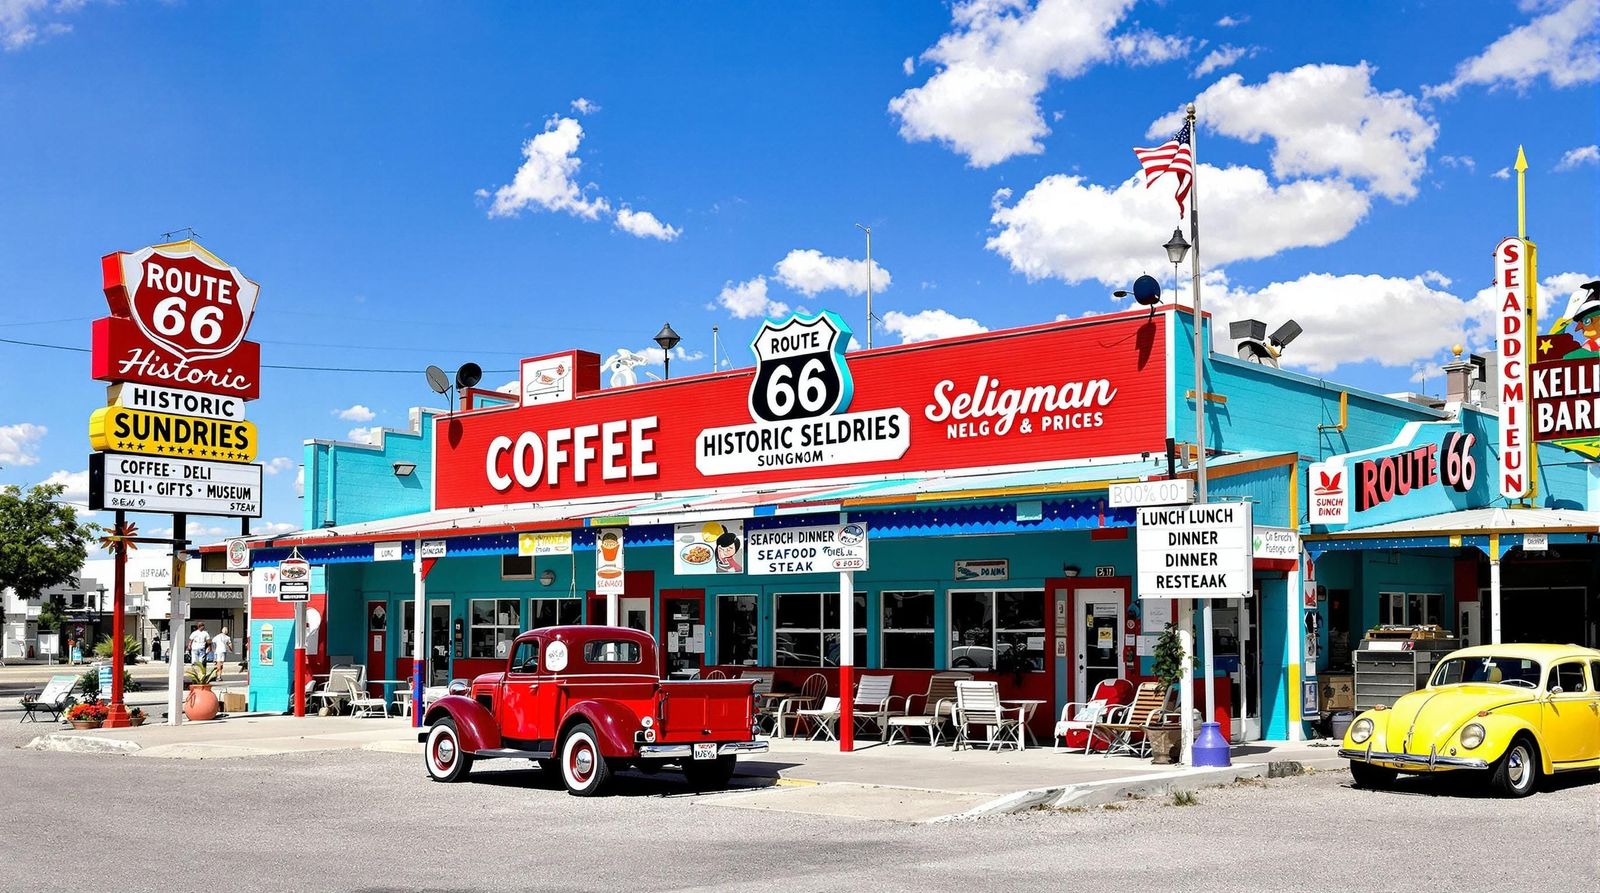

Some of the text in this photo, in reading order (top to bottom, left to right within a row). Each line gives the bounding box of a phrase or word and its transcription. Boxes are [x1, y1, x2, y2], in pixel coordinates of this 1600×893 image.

[147, 261, 233, 305] ROUTE
[152, 296, 224, 346] 66
[771, 331, 820, 354] ROUTE
[118, 347, 252, 391] Historic
[766, 357, 827, 417] 66
[134, 387, 235, 417] HISTORIC
[924, 375, 1118, 436] Seligman
[114, 411, 249, 450] SUNDRIES
[703, 414, 901, 457] HISTORIC SELDRIES
[947, 411, 1104, 439] NELG & PRICES
[486, 415, 659, 492] COFFEE
[120, 459, 211, 480] COFFEE DELI
[1359, 431, 1476, 512] ROUTE 66
[114, 479, 251, 500] DELI GIFTS MUSEUM
[230, 502, 256, 512] STEAK
[1142, 508, 1233, 526] LUNCH LUNCH
[798, 530, 835, 544] DINNER
[1168, 530, 1218, 546] DINNER
[757, 548, 817, 560] SEAFOOD
[1165, 552, 1218, 567] DINNER
[768, 561, 813, 573] STEAK
[1156, 573, 1227, 589] RESTEAAK
